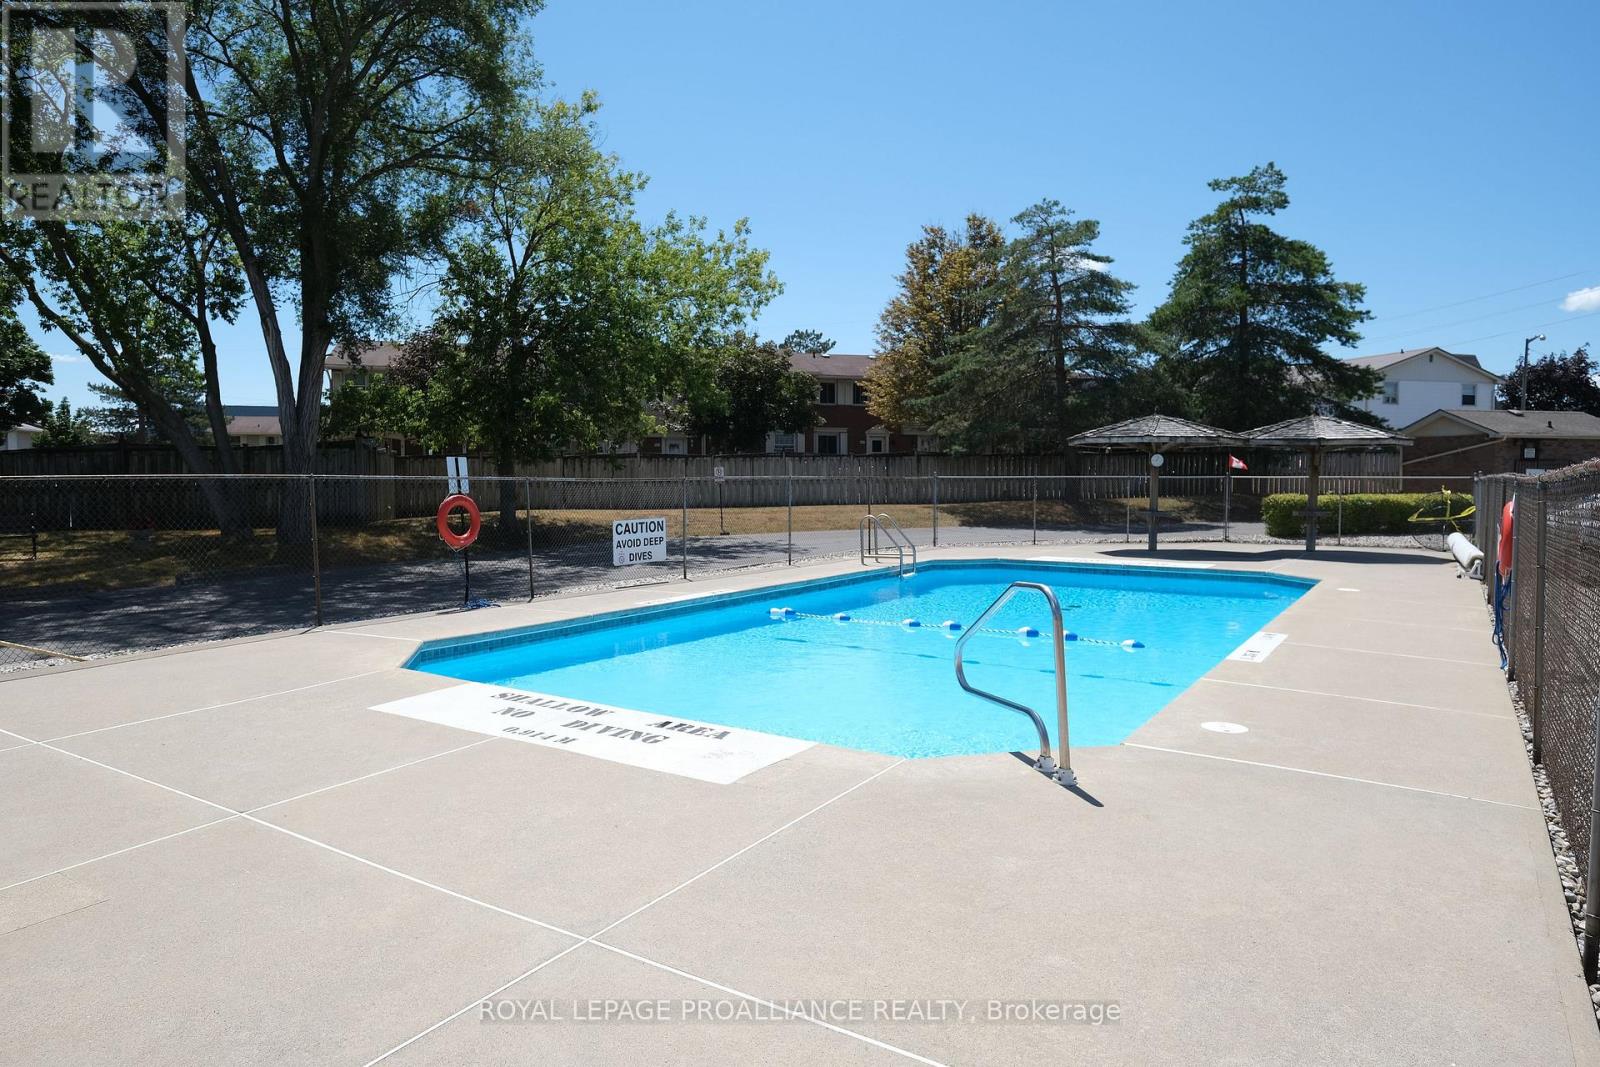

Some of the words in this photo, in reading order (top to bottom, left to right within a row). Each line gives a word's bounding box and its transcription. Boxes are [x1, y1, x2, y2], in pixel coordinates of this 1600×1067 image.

[615, 520, 664, 535] CAUTION
[616, 538, 641, 549] AVOID
[643, 536, 664, 546] DEEP
[629, 551, 652, 561] DIVES
[490, 692, 615, 717] SHALLOW
[646, 720, 731, 740] AREA
[491, 707, 535, 718] NO
[560, 719, 670, 744] DIVING
